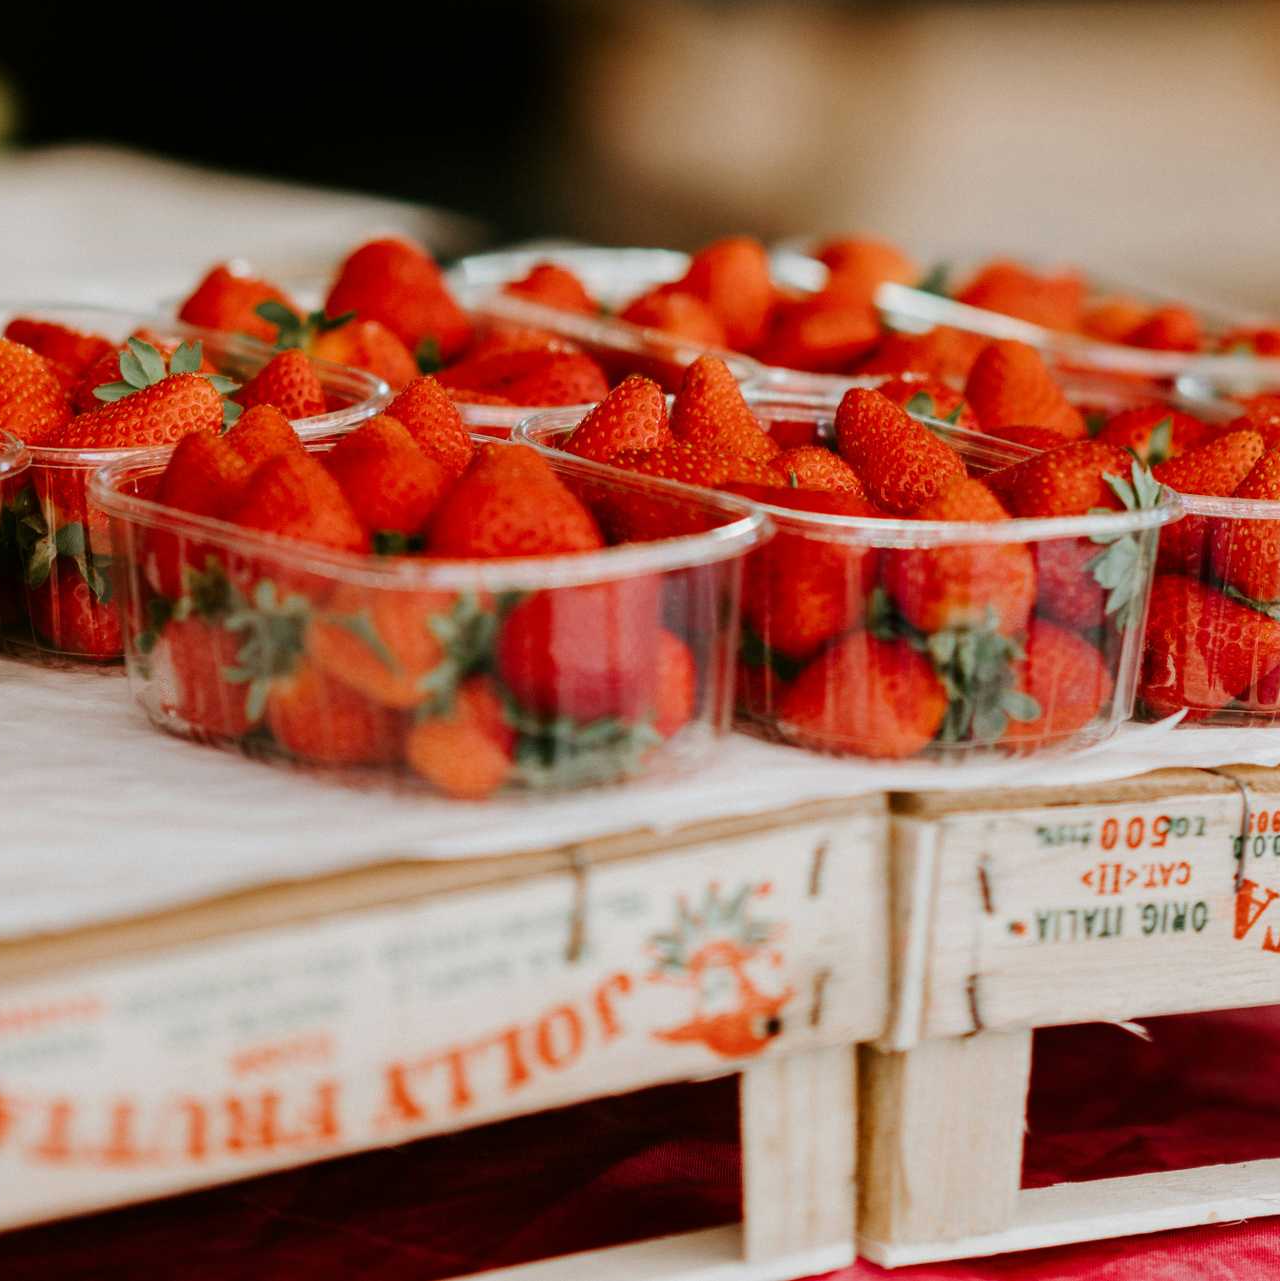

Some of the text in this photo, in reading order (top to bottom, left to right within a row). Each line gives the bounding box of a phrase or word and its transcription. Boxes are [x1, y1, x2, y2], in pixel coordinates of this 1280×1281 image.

[1100, 815, 1171, 851] 500
[1036, 906, 1123, 941] ITALIA
[367, 972, 634, 1128] JOLLY
